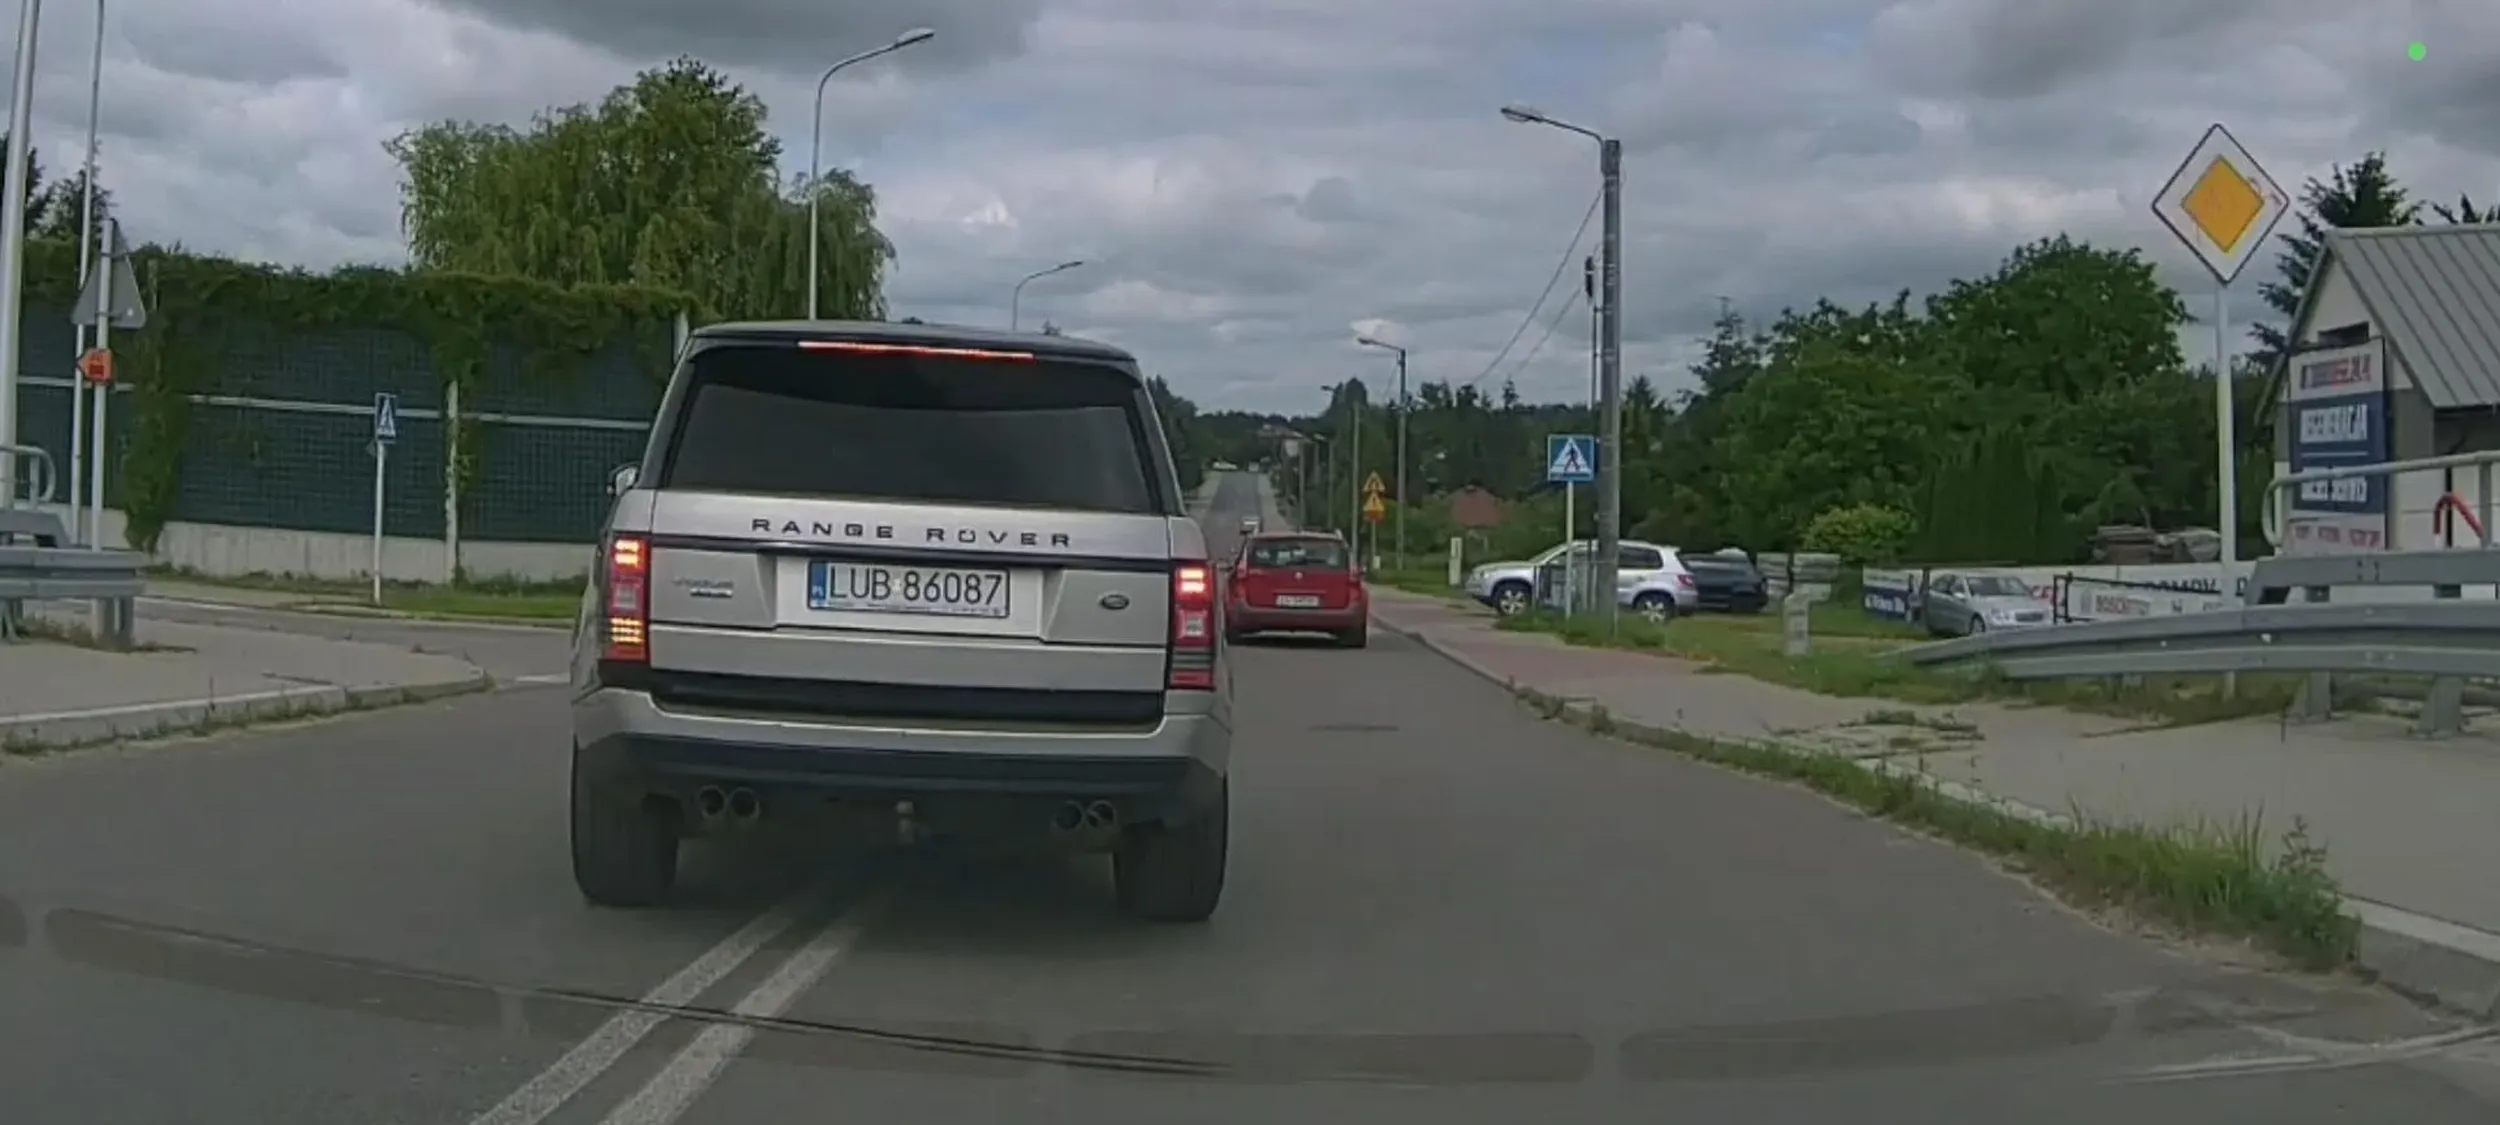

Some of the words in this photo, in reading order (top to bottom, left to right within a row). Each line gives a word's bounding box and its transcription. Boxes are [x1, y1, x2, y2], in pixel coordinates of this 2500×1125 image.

[752, 518, 893, 539] RANGE
[926, 528, 1070, 547] ROVER
[830, 566, 891, 600] LUB
[903, 570, 1003, 605] 86087
